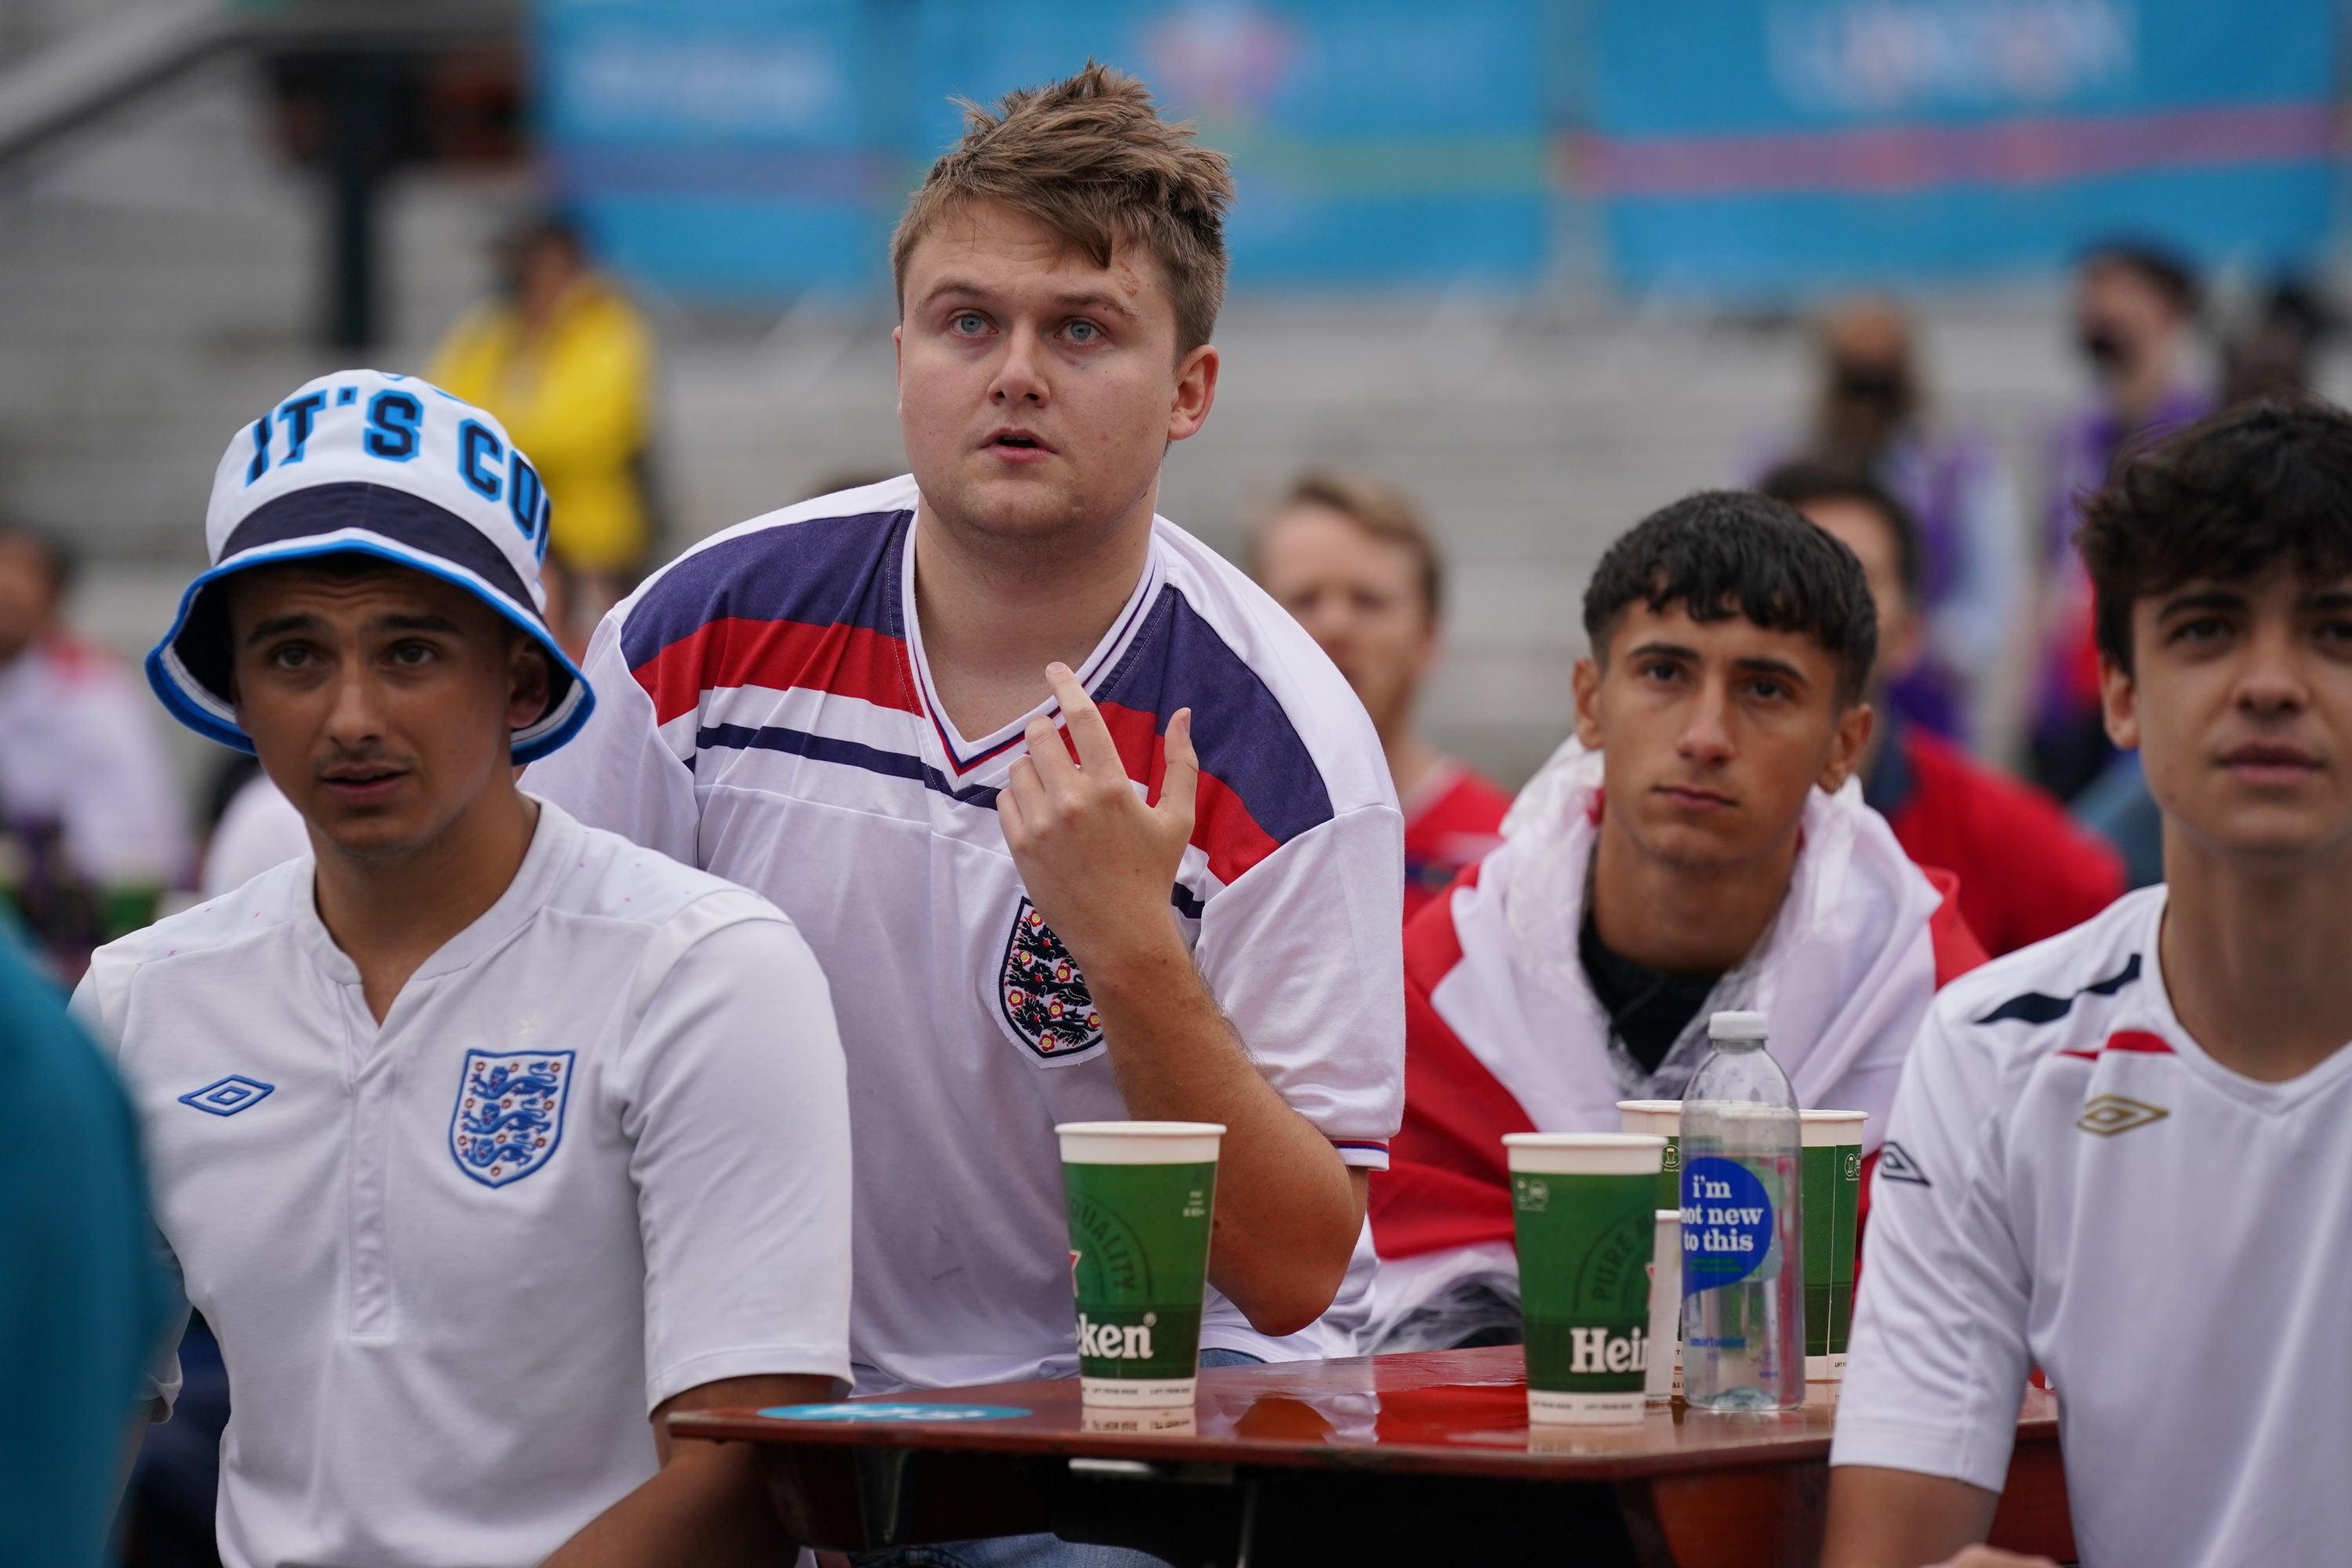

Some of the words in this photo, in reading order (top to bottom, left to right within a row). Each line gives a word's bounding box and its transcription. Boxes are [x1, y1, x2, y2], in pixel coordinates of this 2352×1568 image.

[245, 387, 424, 488] IT'S
[1692, 1174, 1733, 1199] i'm
[1707, 1207, 1765, 1225] new
[1683, 1229, 1700, 1252] to
[1703, 1227, 1755, 1252] this
